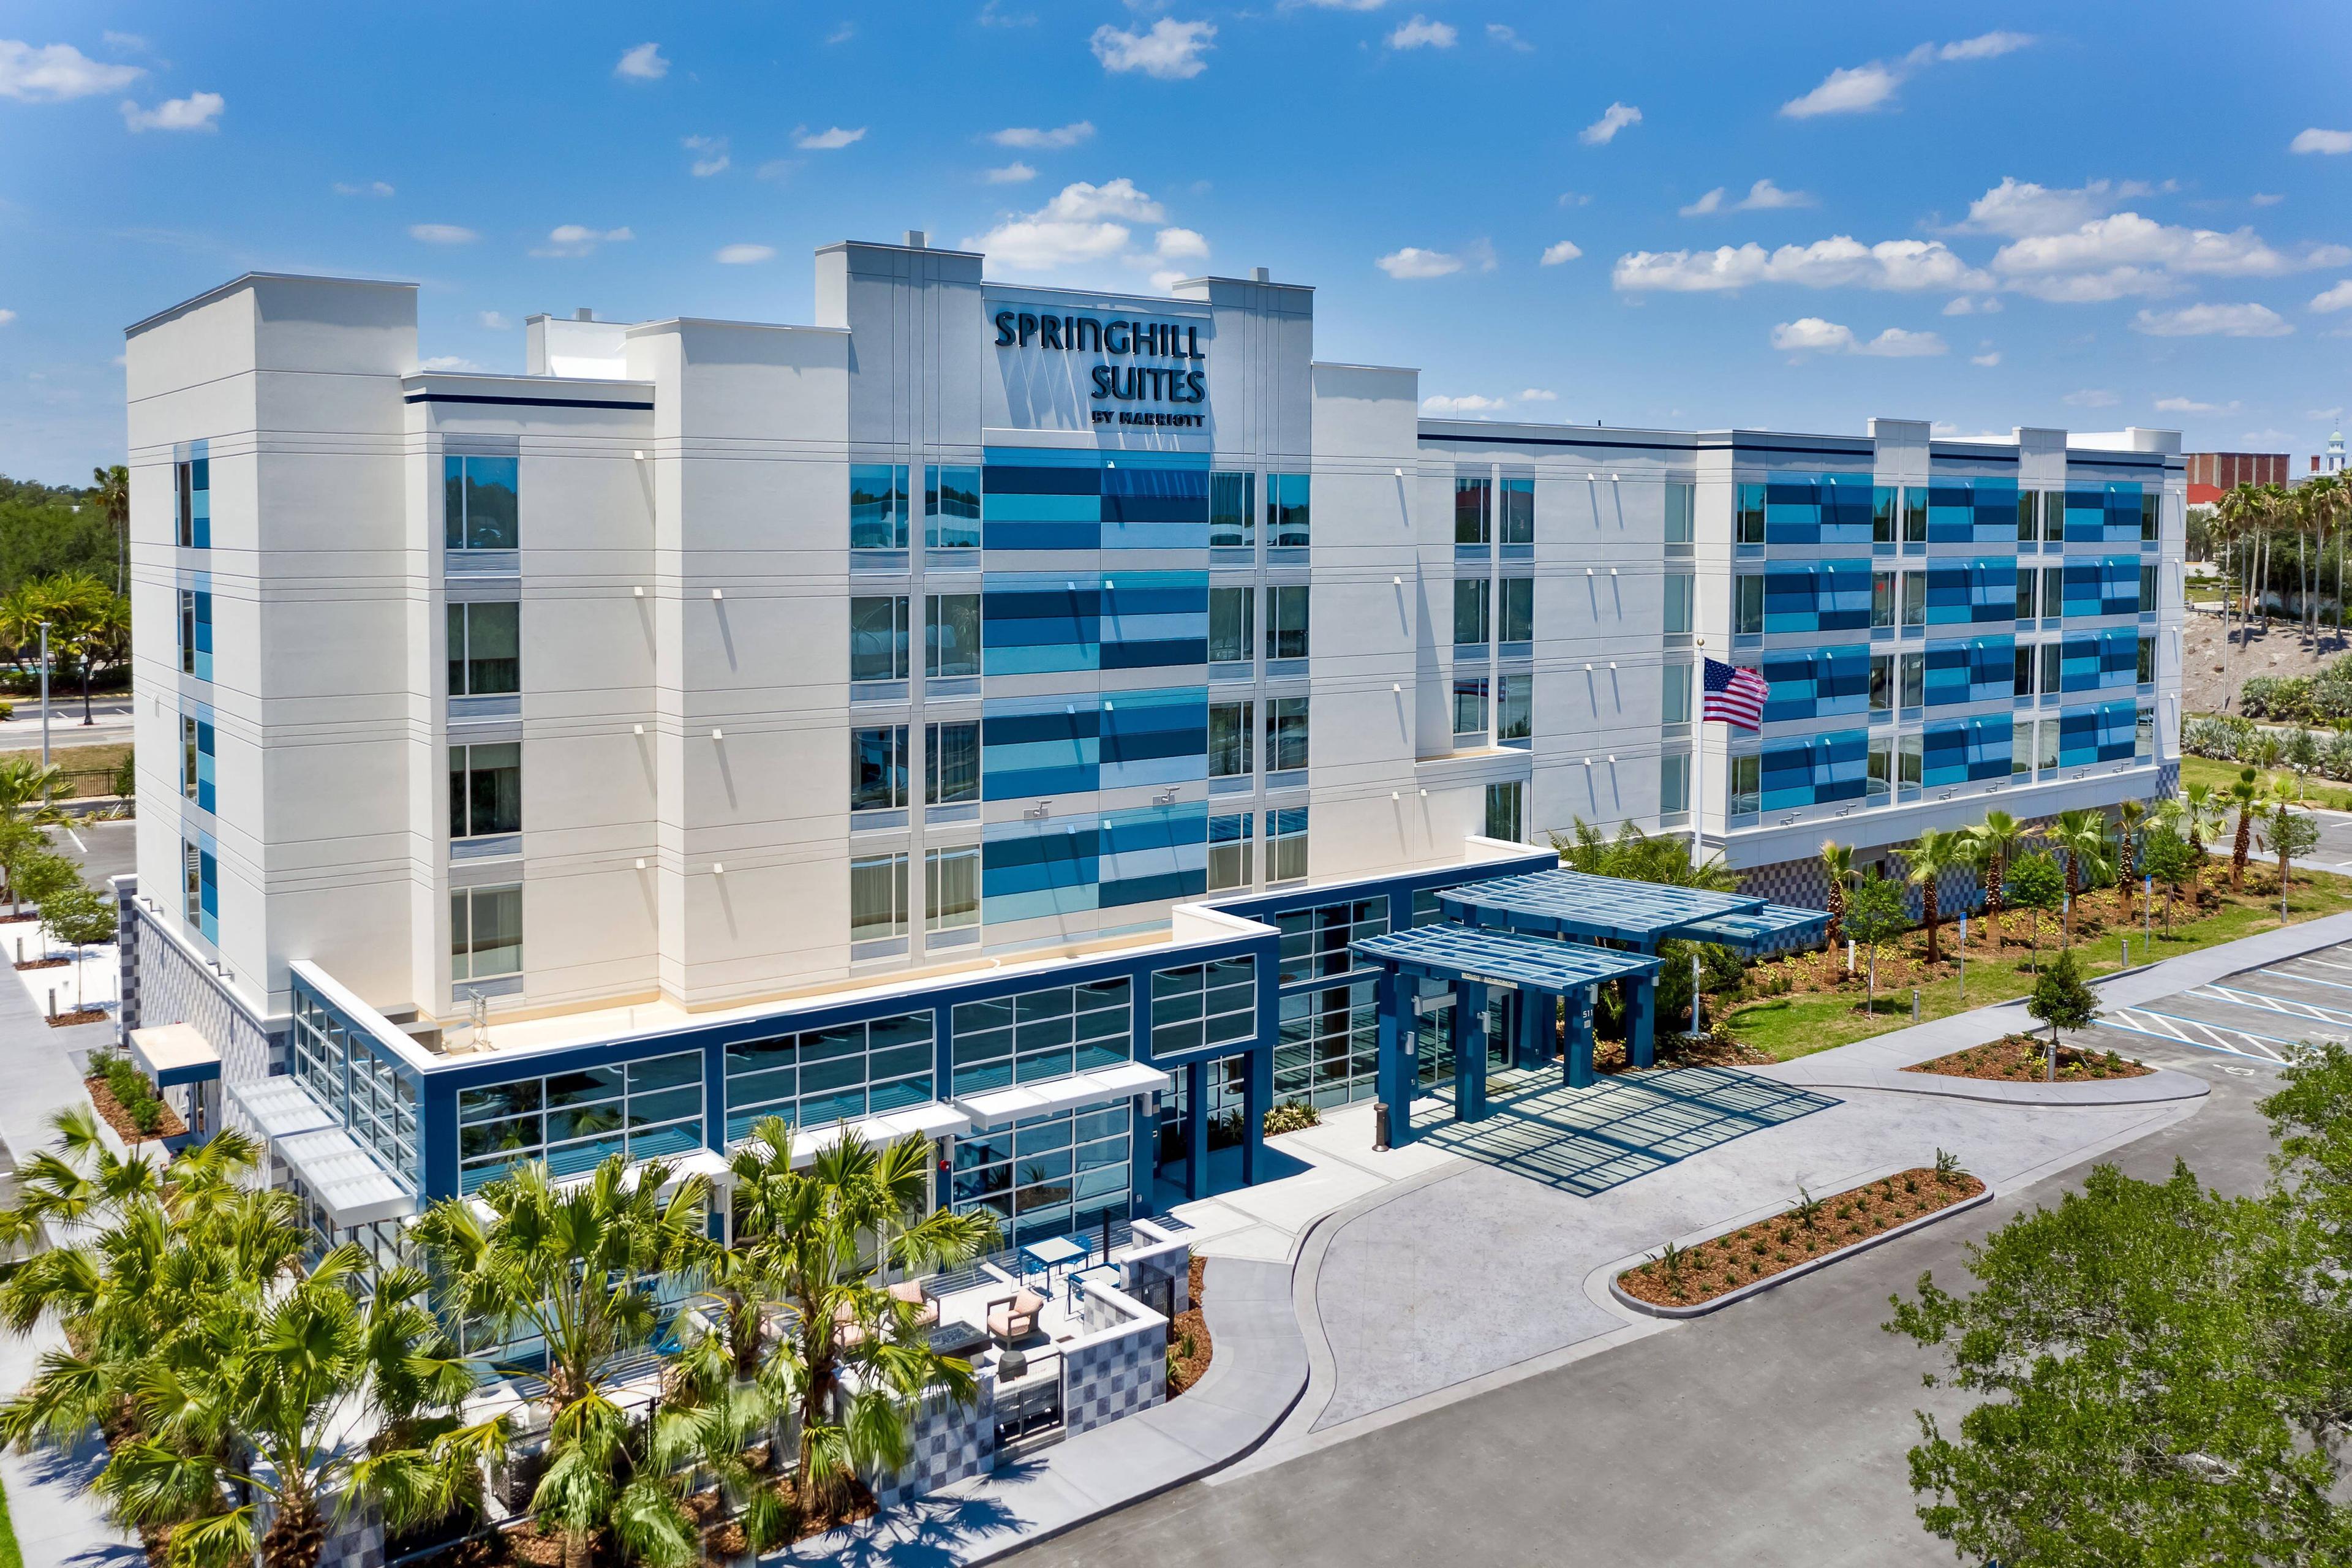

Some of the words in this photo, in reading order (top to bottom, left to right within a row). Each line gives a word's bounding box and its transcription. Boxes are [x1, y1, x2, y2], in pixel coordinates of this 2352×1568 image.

[995, 311, 1205, 359] SPRINGHILL
[1091, 365, 1205, 403] SUITES
[1092, 410, 1115, 423] BY
[1120, 412, 1205, 427] MARRIOTT
[1583, 1009, 1593, 1018] 511
